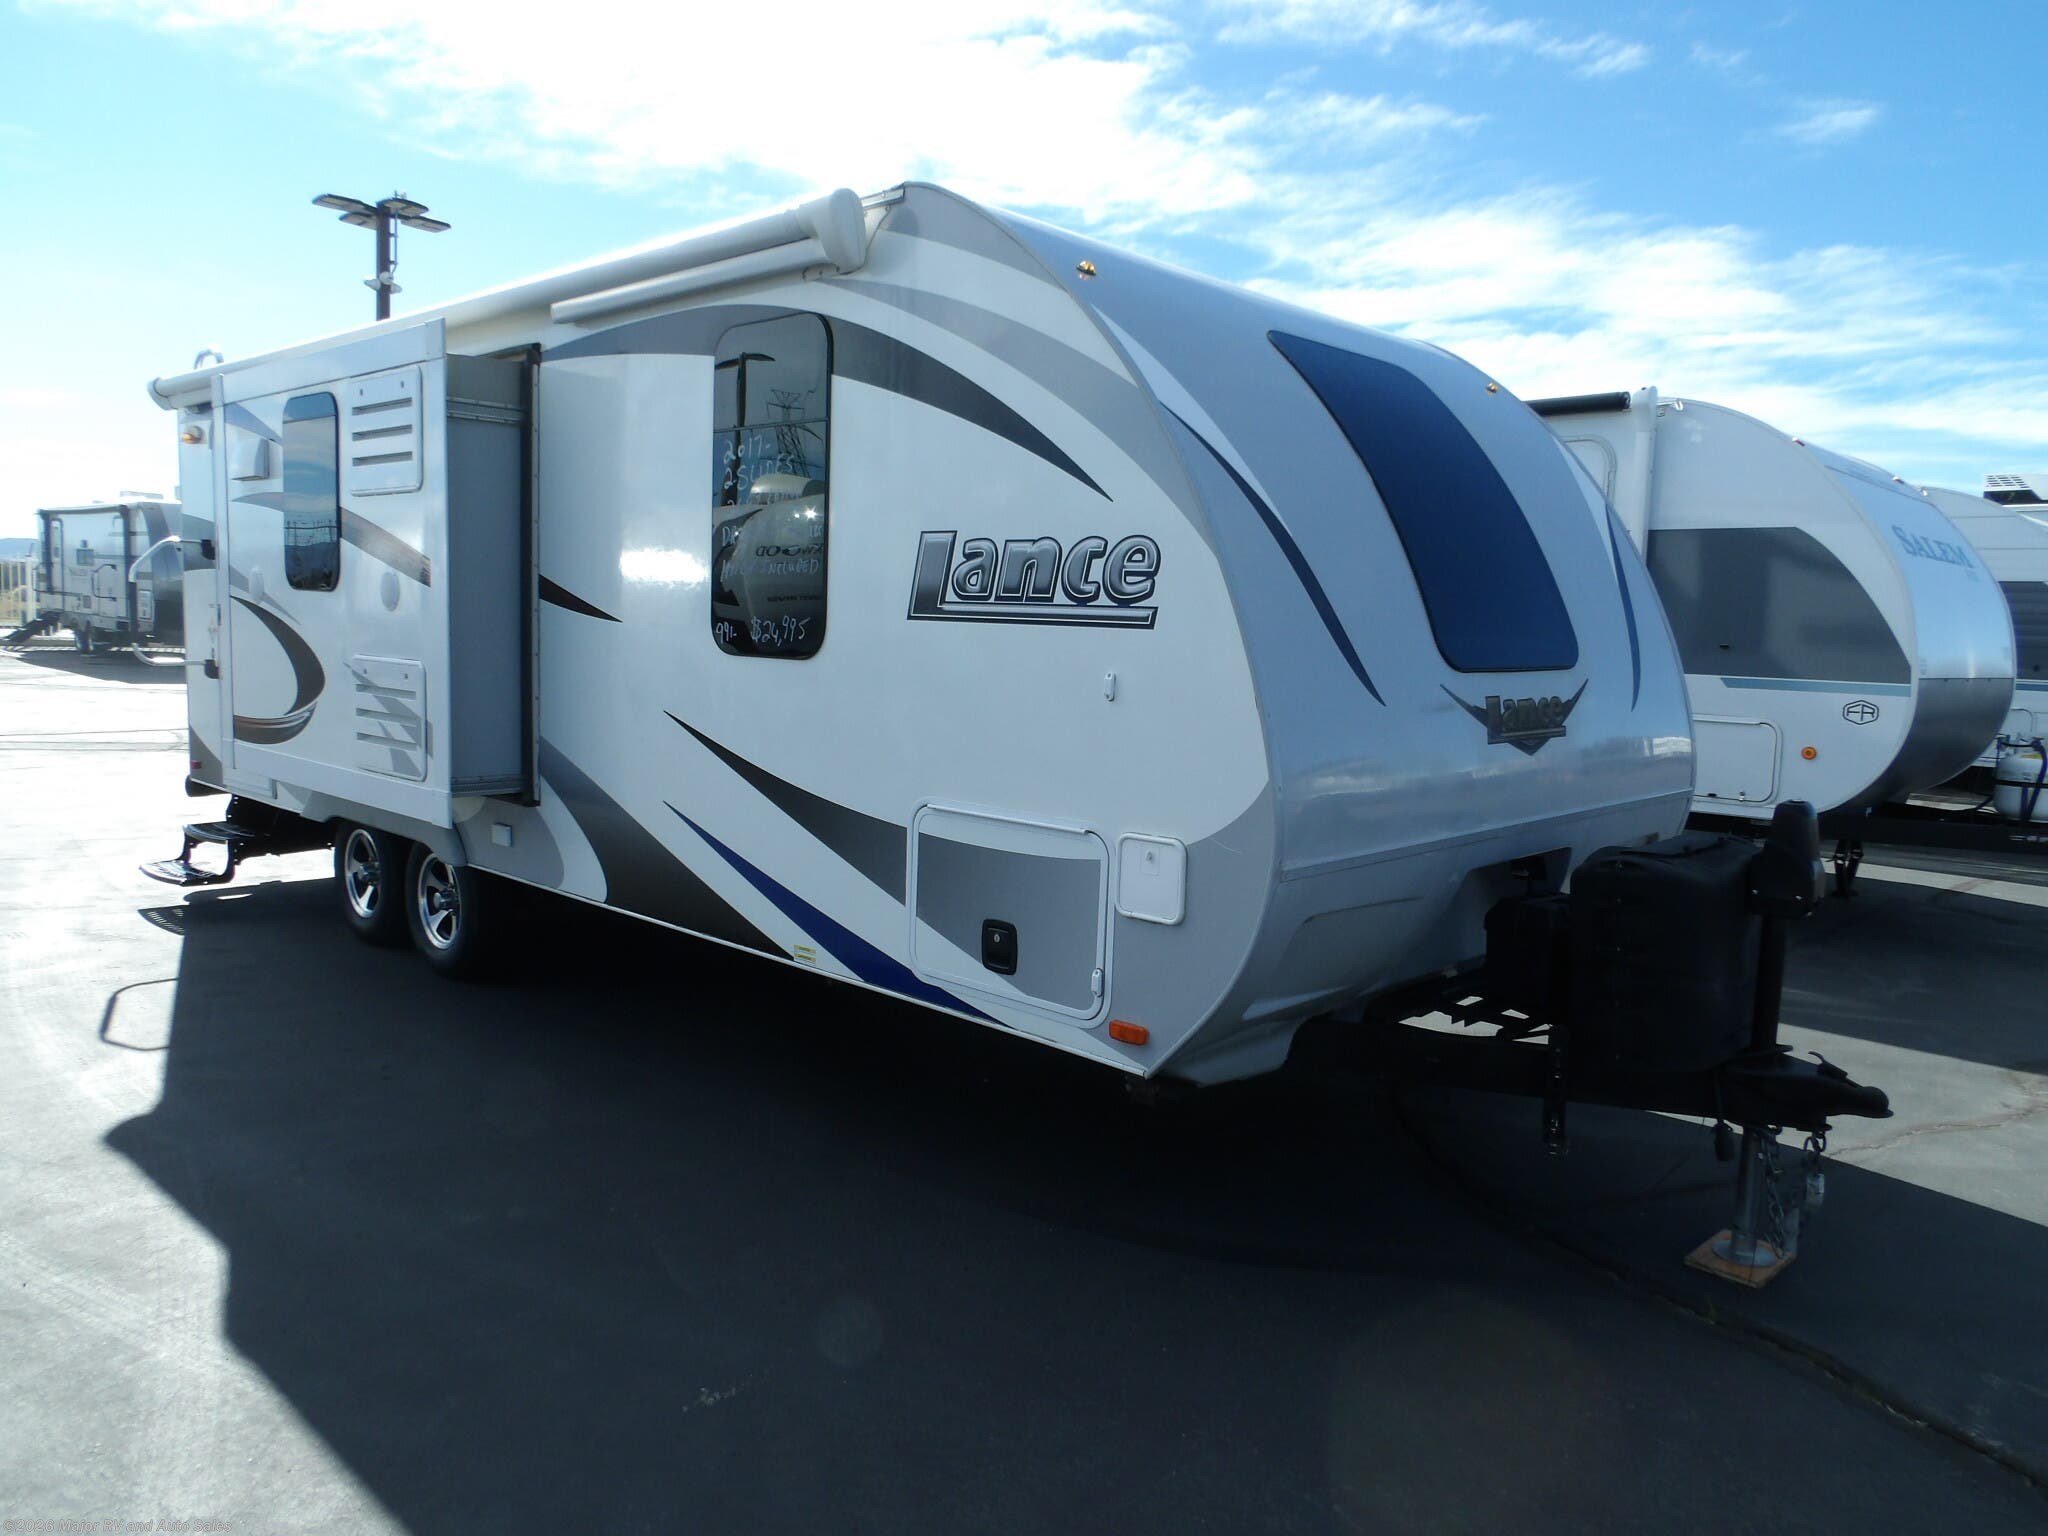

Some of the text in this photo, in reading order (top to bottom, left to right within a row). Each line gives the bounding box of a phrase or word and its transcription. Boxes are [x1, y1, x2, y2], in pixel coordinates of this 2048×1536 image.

[1891, 525, 1974, 569] SALEM
[907, 529, 1161, 629] Lance
[1485, 695, 1566, 745] Lance
